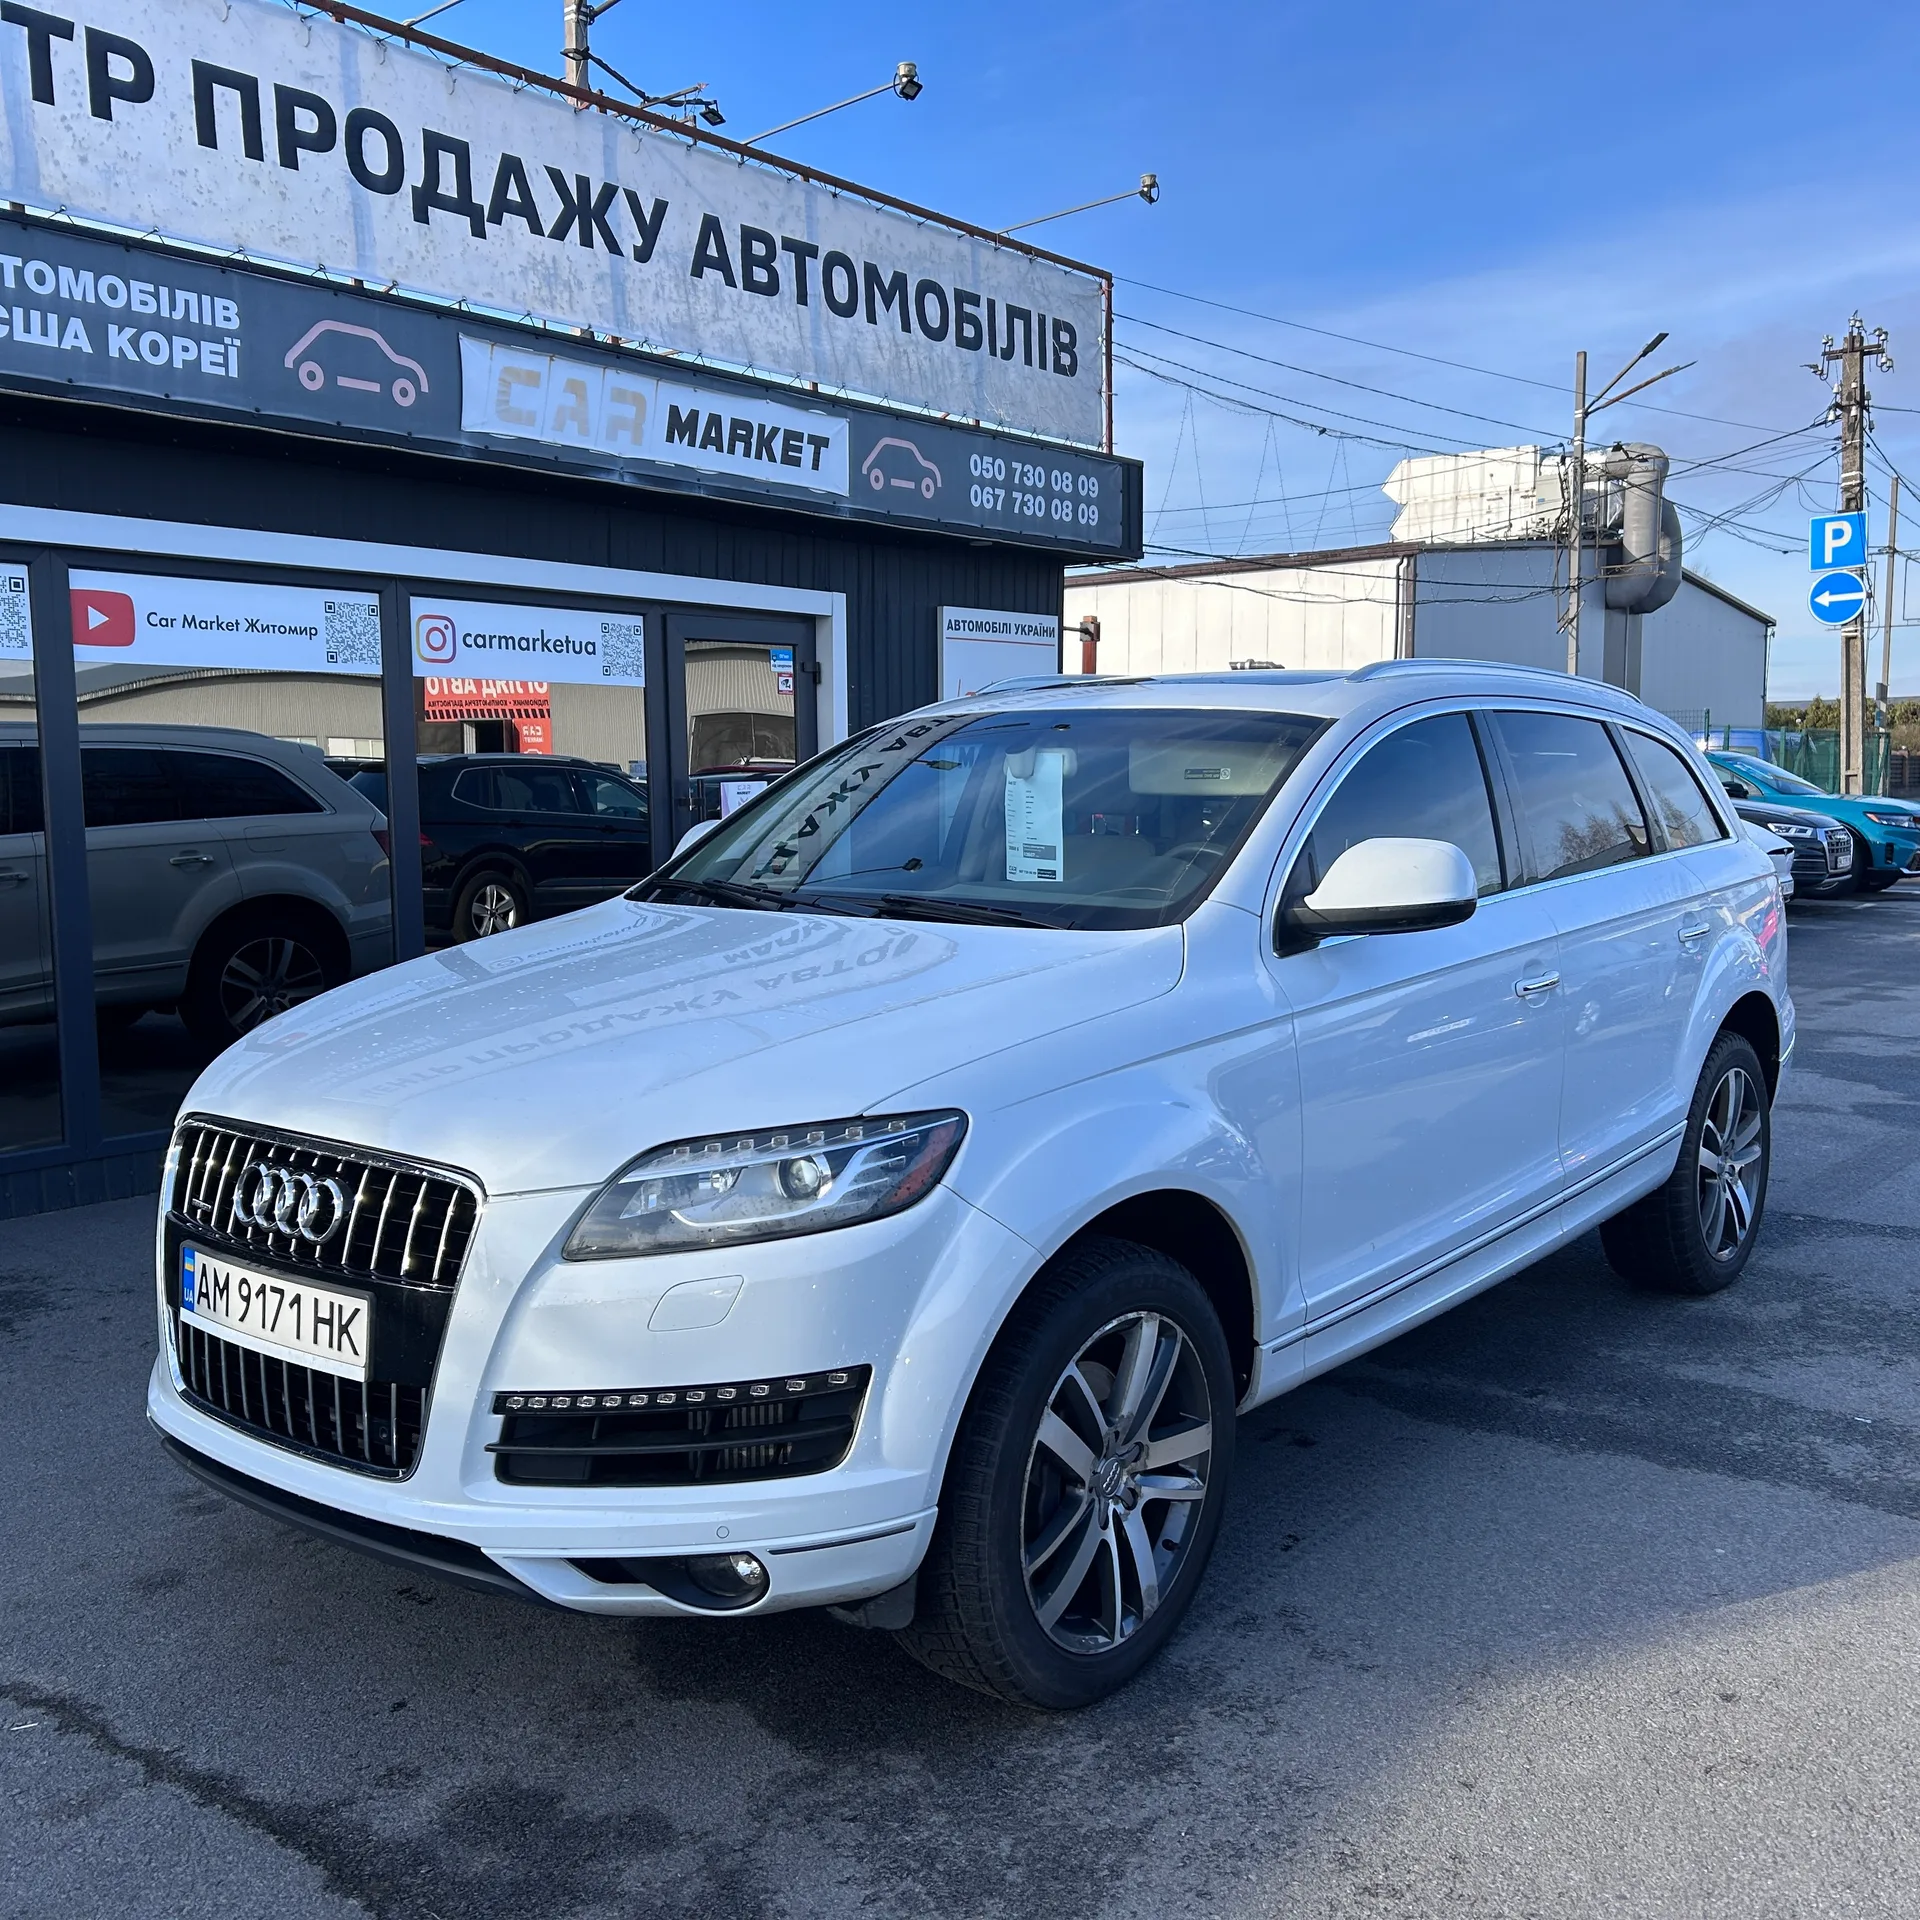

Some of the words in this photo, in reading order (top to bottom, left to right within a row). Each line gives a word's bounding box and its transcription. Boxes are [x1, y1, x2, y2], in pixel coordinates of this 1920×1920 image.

[0, 4, 154, 121] ТР
[191, 58, 668, 263] ПРОДАЖУ
[690, 213, 1078, 378] АВТОМОБІЛІВ
[0, 254, 240, 330] ТОМОБІЛІВ
[108, 323, 241, 378] КОРЕЇ
[494, 365, 646, 446] CAR
[665, 404, 830, 471] MARKET
[970, 454, 1006, 481] 050
[1012, 461, 1045, 488] 730
[1051, 469, 1073, 493] 08
[1078, 474, 1099, 498] 09
[970, 484, 1006, 511] 067
[1012, 491, 1045, 517] 730
[1051, 498, 1073, 522] 08
[1078, 503, 1099, 526] 09
[1824, 520, 1852, 564] P
[146, 612, 176, 628] Car
[182, 614, 240, 632] Market
[244, 617, 318, 640] Житомир
[462, 629, 597, 656] carmarketua
[946, 619, 1011, 634] АВТОМОБІЛІ
[1014, 623, 1055, 638] УКРАЇНИ
[184, 1287, 194, 1304] UA
[197, 1263, 231, 1318] AM
[238, 1277, 301, 1339] 9171
[313, 1297, 360, 1357] HK
